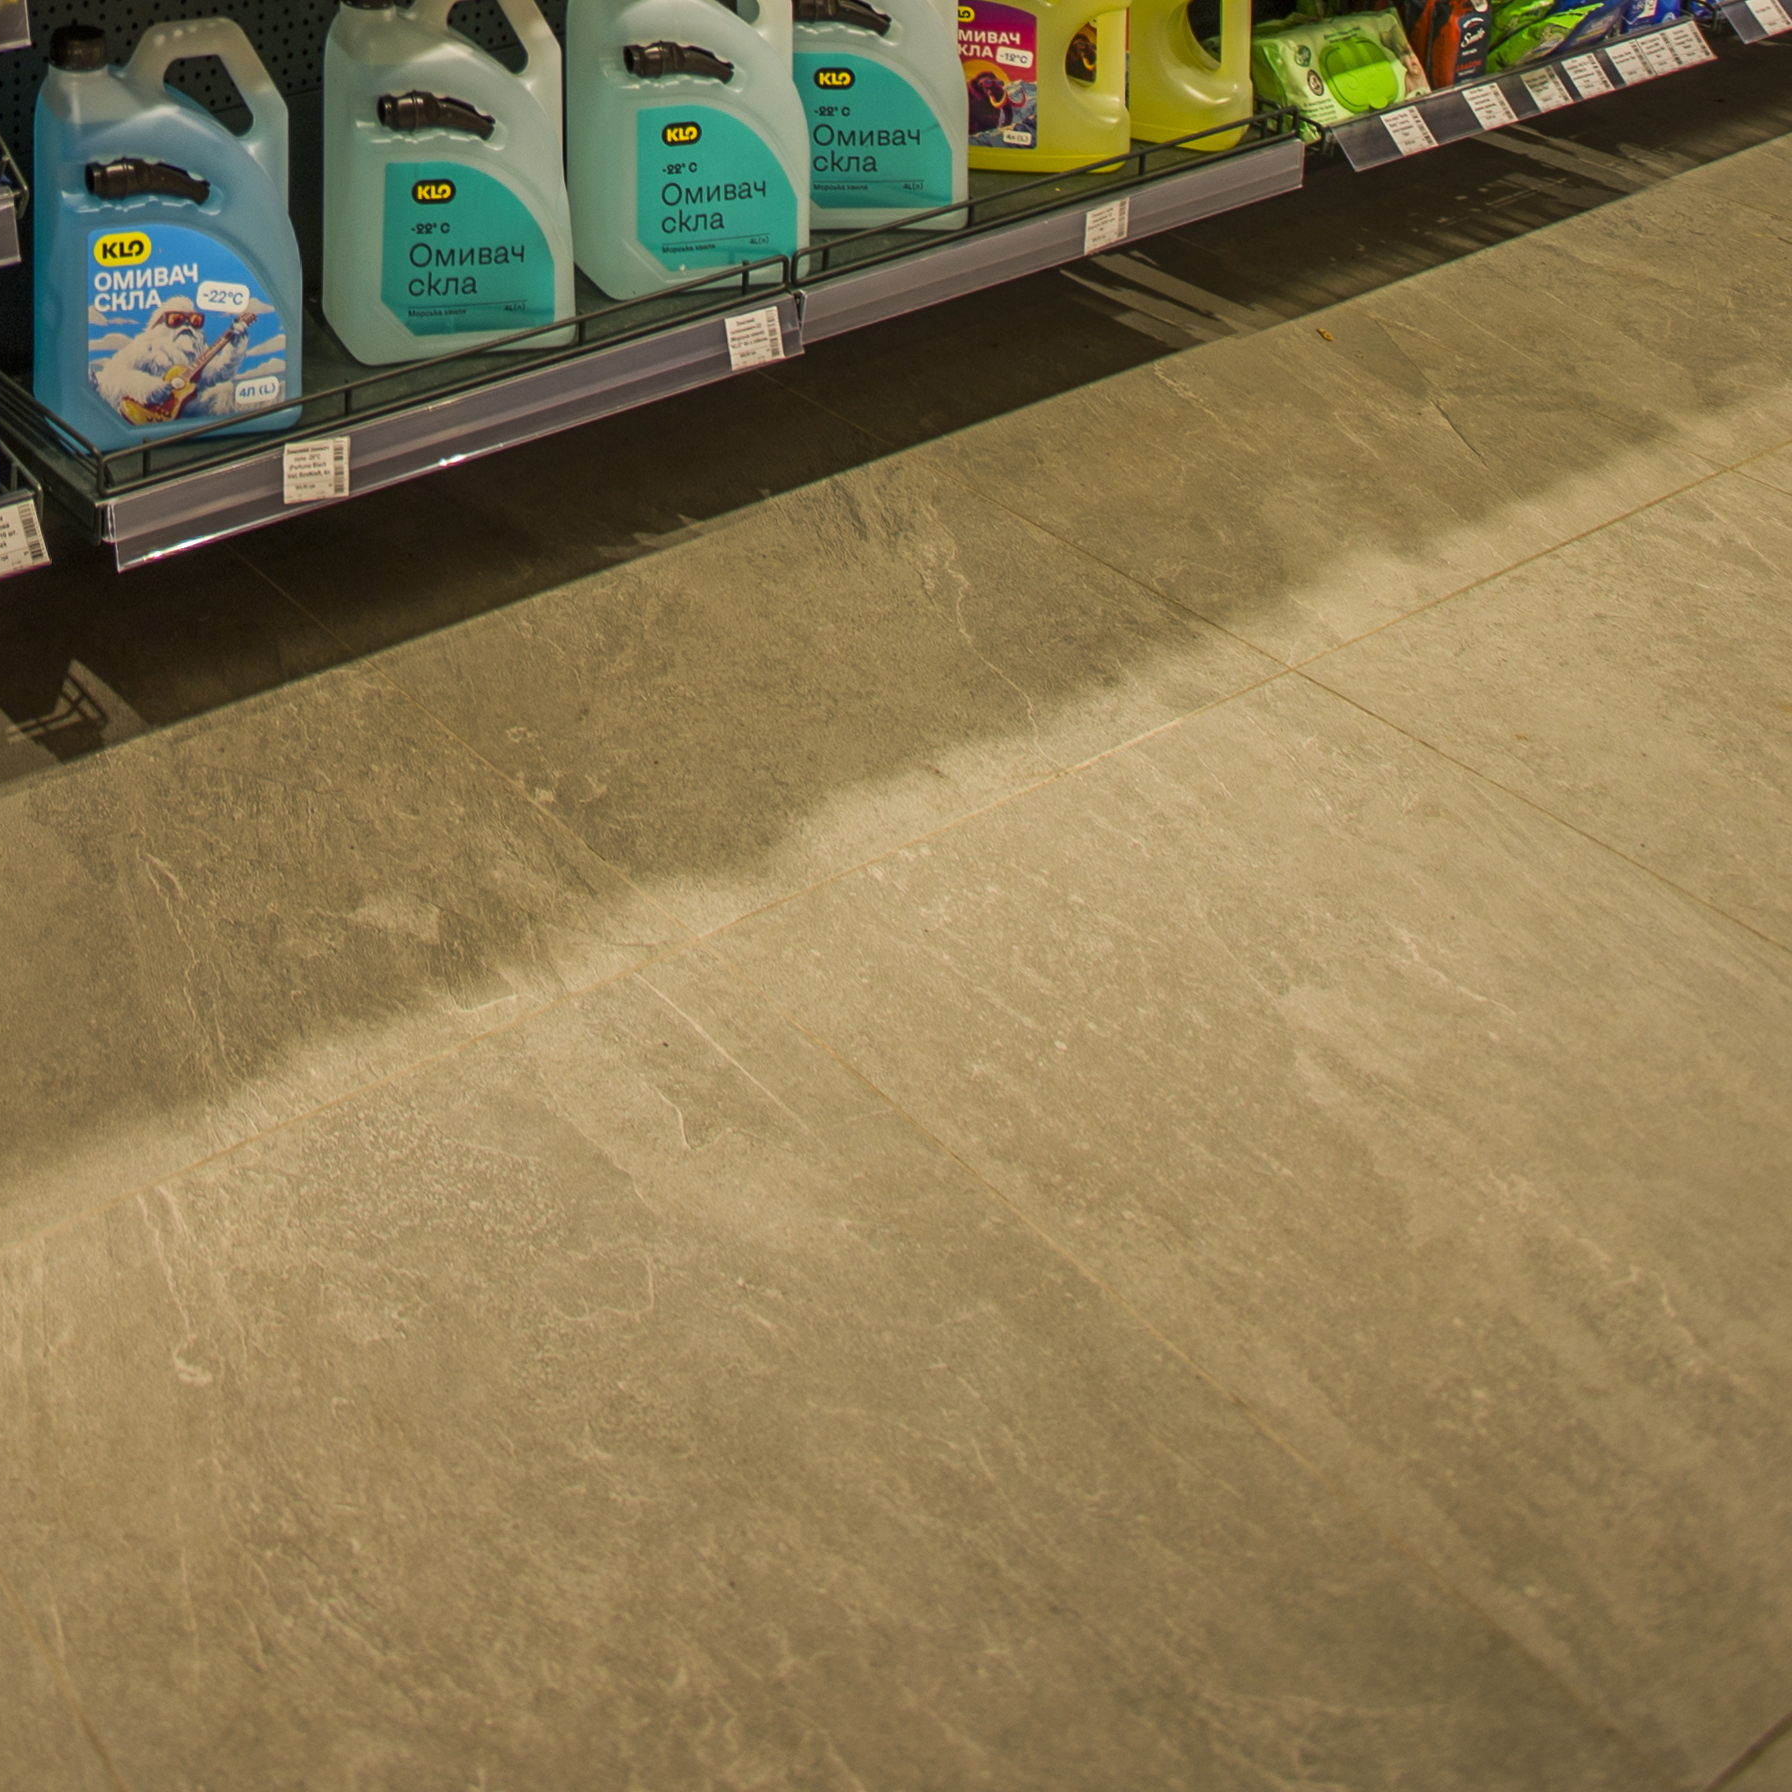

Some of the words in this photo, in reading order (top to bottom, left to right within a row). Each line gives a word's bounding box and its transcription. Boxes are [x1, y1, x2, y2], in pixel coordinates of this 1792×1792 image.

[661, 179, 767, 207] Омивач
[661, 207, 724, 234] скла
[409, 242, 526, 269] Омивач
[94, 264, 199, 291] ОМИВАЧ
[407, 271, 477, 297] скла
[94, 290, 162, 312] СКЛА
[238, 385, 255, 399] 4Л
[257, 382, 275, 399] (L)
